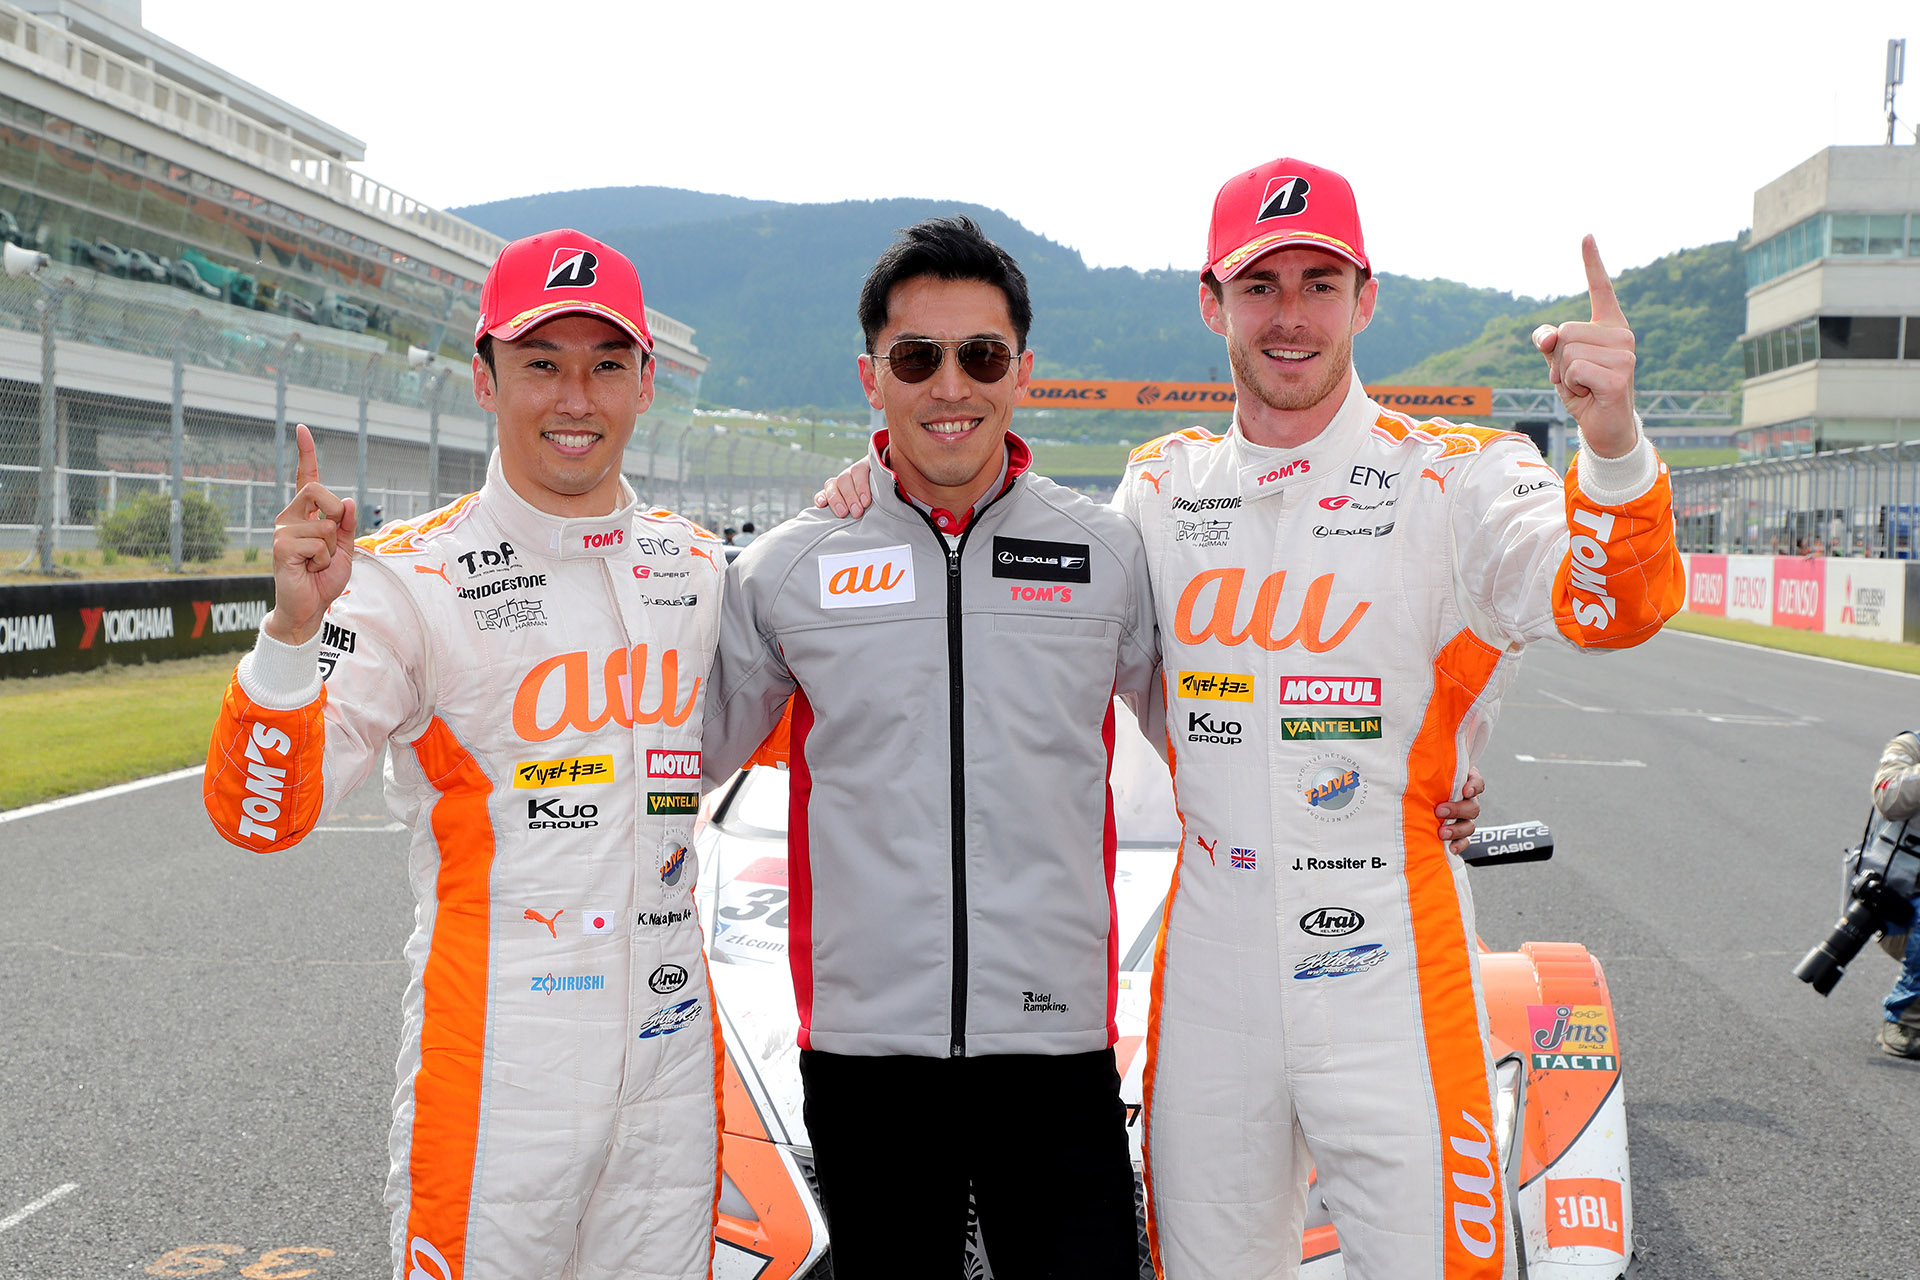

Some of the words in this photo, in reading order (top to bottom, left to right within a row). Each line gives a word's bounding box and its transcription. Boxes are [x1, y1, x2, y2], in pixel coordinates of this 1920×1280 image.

[1028, 388, 1108, 400] OBACS
[1257, 459, 1310, 486] TOM'S
[583, 529, 624, 548] TOM'S
[1329, 528, 1373, 536] LEXUS
[636, 538, 680, 555] ENG
[1016, 556, 1058, 564] LEXUS
[1571, 508, 1616, 631] TOM'S
[456, 574, 547, 600] BRIDGESTONE
[828, 562, 905, 595] au
[1693, 572, 1723, 605] DENSO
[650, 598, 682, 606] LEXUS
[1011, 586, 1072, 603] TOM'S
[1733, 576, 1767, 610] DENSO
[1778, 578, 1819, 617] DENSO
[1174, 567, 1373, 653] au
[103, 607, 174, 643] YOKOHAMA
[512, 643, 702, 741] au
[1182, 675, 1250, 697] マツモトキヨシ
[1283, 680, 1377, 702] MOTUL
[1188, 734, 1242, 745] GROUP
[1284, 719, 1379, 738] VANTELIN
[519, 760, 608, 785] マツモトキヨシ
[649, 753, 700, 775] MOTUL
[238, 721, 291, 842] TOM'S
[1304, 770, 1360, 806] T-LIVE
[529, 820, 598, 829] GROUP
[1470, 826, 1549, 844] EDIFICE
[1487, 841, 1535, 856] CASIO
[1292, 857, 1303, 871] J.
[1307, 857, 1366, 870] Rossiter
[1371, 857, 1387, 869] B-
[638, 913, 648, 925] K.
[1304, 911, 1357, 930] Arai
[531, 974, 604, 995] ZOJIRUSHI
[1022, 991, 1051, 1002] Ridel
[1533, 1006, 1608, 1050] jms
[1536, 1055, 1613, 1070] TACTI
[1450, 1110, 1496, 1258] au
[1558, 1195, 1618, 1233] JBL
